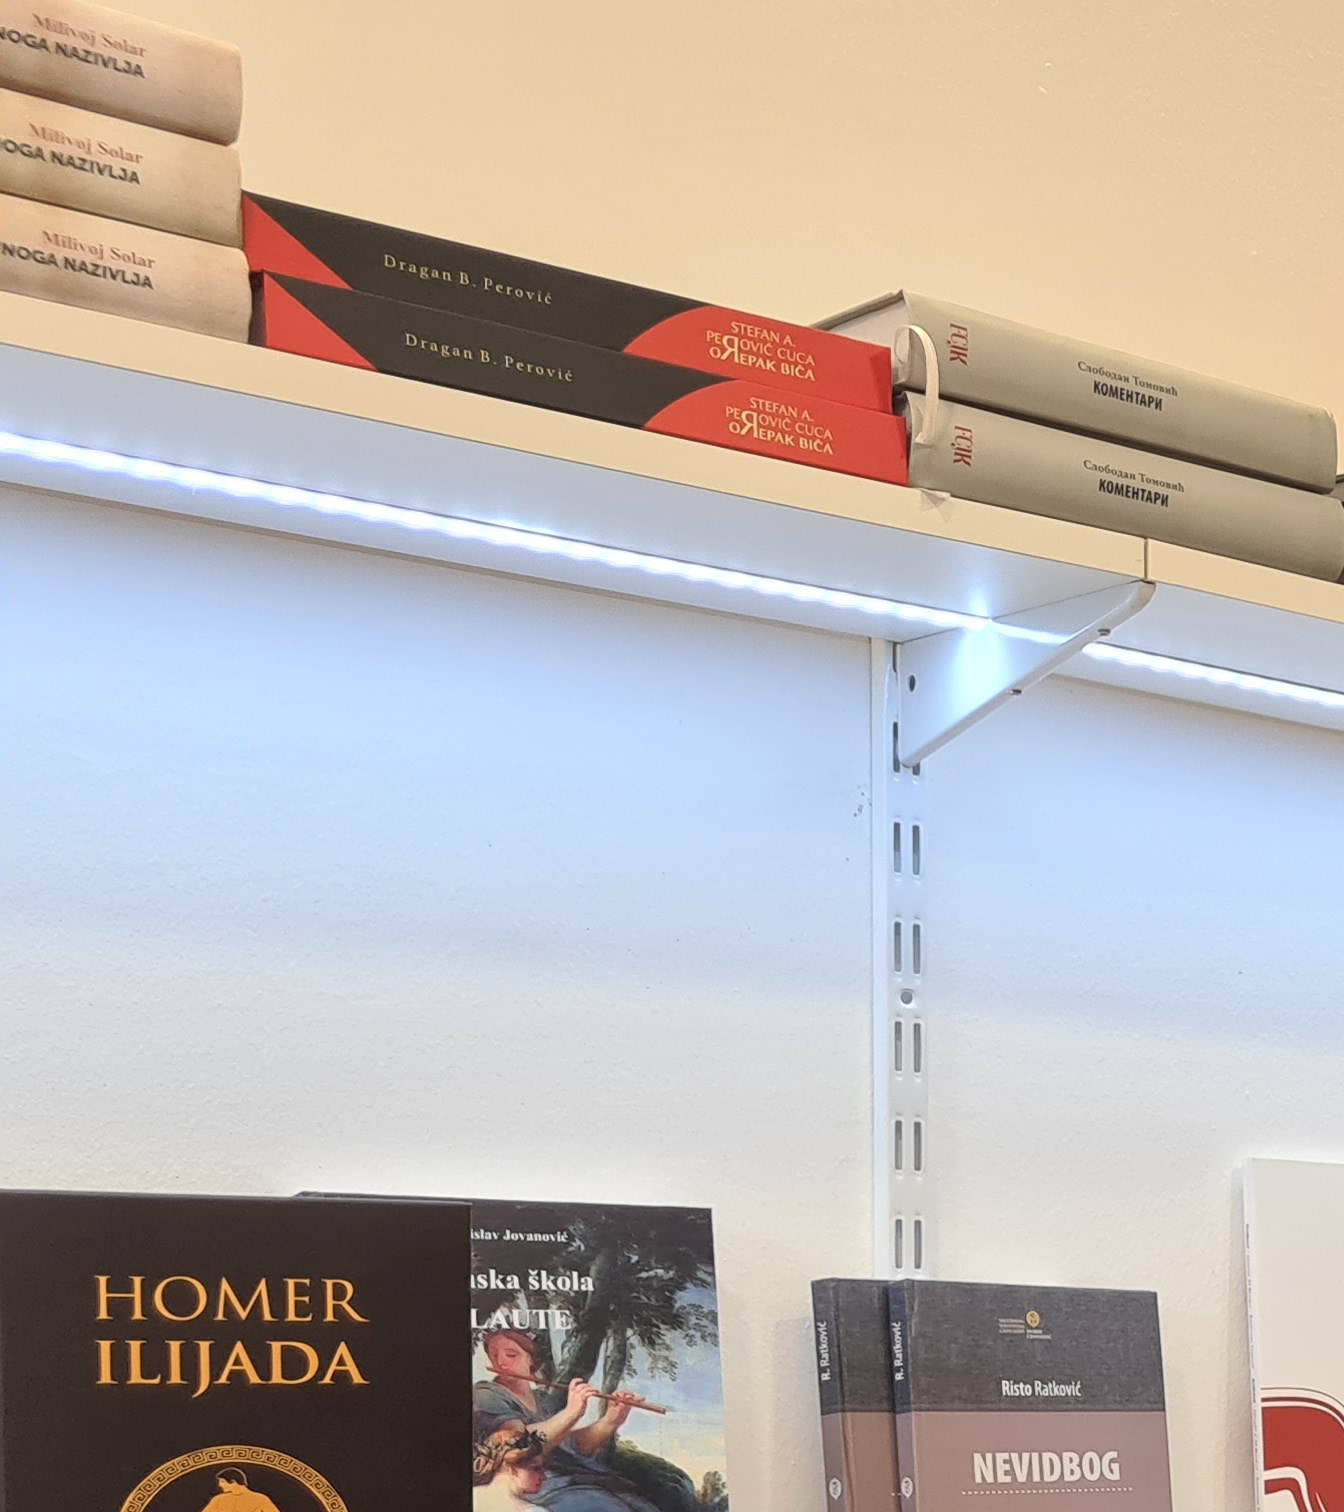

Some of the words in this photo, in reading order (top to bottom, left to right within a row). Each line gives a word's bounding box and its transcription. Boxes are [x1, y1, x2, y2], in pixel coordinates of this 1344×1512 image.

[33, 14, 96, 48] Milivoj
[101, 31, 146, 58] Solar
[383, 254, 452, 282] Dragan
[458, 272, 476, 287] B.
[484, 276, 553, 306] Perović
[731, 321, 779, 344] STEFAN
[781, 330, 796, 348] A.
[405, 333, 473, 361] Dragan
[480, 348, 498, 364] B.
[504, 354, 574, 383] Perović
[1077, 360, 1129, 384] Слободан
[1132, 375, 1179, 397] Томовић
[1093, 380, 1163, 411] КОМЕНТАРИ
[94, 1274, 370, 1323] HOMER
[817, 1321, 830, 1368] Ratković
[94, 1339, 370, 1398] ILIJADA
[820, 1369, 832, 1381] R.
[1002, 1380, 1032, 1396] Risto
[1034, 1380, 1082, 1397] Ratković
[973, 1451, 1122, 1483] NEVIDBOG
